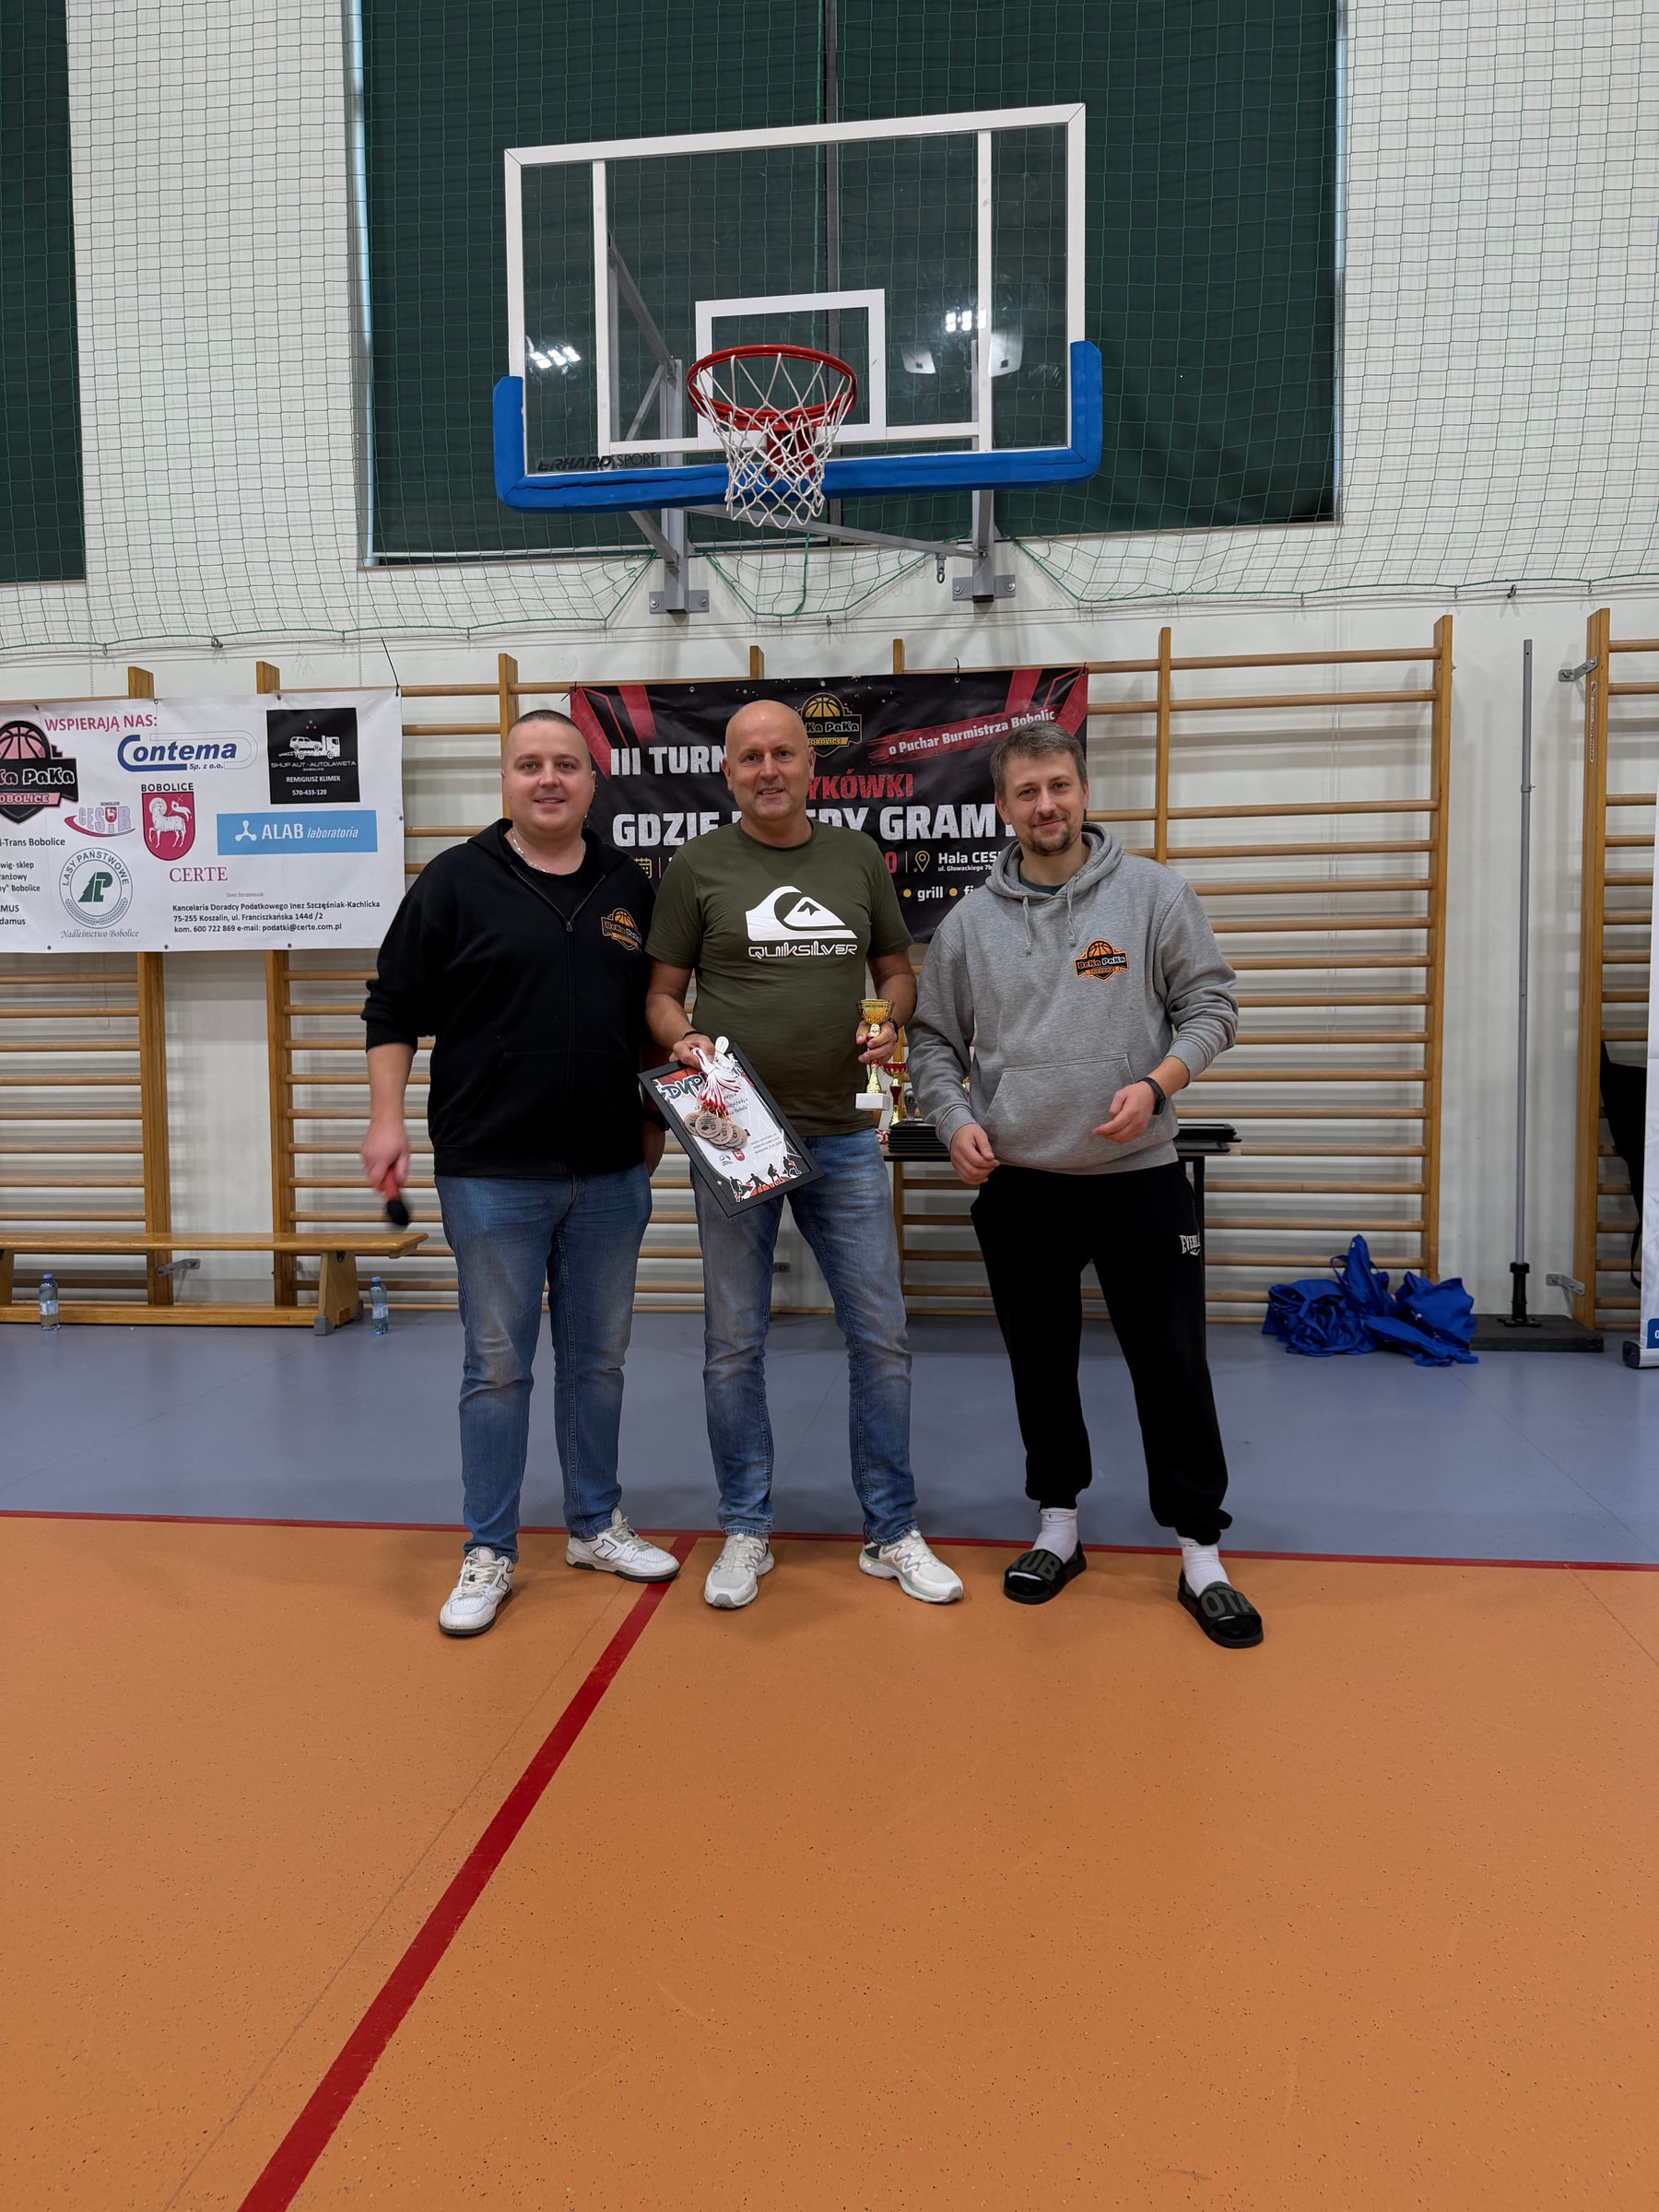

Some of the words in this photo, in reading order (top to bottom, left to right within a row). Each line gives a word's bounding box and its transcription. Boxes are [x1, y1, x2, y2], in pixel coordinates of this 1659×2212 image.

[617, 453, 656, 466] SPORT
[44, 716, 120, 732] WSPIERAJĄ
[124, 714, 158, 728] NAS:
[888, 746, 897, 755] o
[899, 736, 939, 755] Puchar
[942, 722, 1009, 745] Burmistrza
[117, 735, 237, 771] Contema
[611, 747, 641, 775] III
[22, 768, 76, 785] PaKa
[141, 782, 194, 792] BOBOLICE
[262, 824, 303, 840] ALAB
[307, 827, 359, 839] laboratoria
[613, 812, 719, 846] GDZIE
[880, 803, 1016, 840] GRAM
[938, 852, 968, 864] Hala
[972, 851, 1001, 864] CES
[62, 861, 76, 886] LASY
[170, 867, 228, 882] CERTE
[917, 886, 944, 901] grill
[241, 902, 288, 911] Podatkowego
[306, 900, 380, 910] Szczęśniak-Kachlicka
[61, 929, 108, 938] Nadleśnictwo
[110, 929, 139, 937] Bobolice
[262, 923, 342, 932] podatki@certe.com.pl
[748, 941, 858, 959] QUIKSILVER
